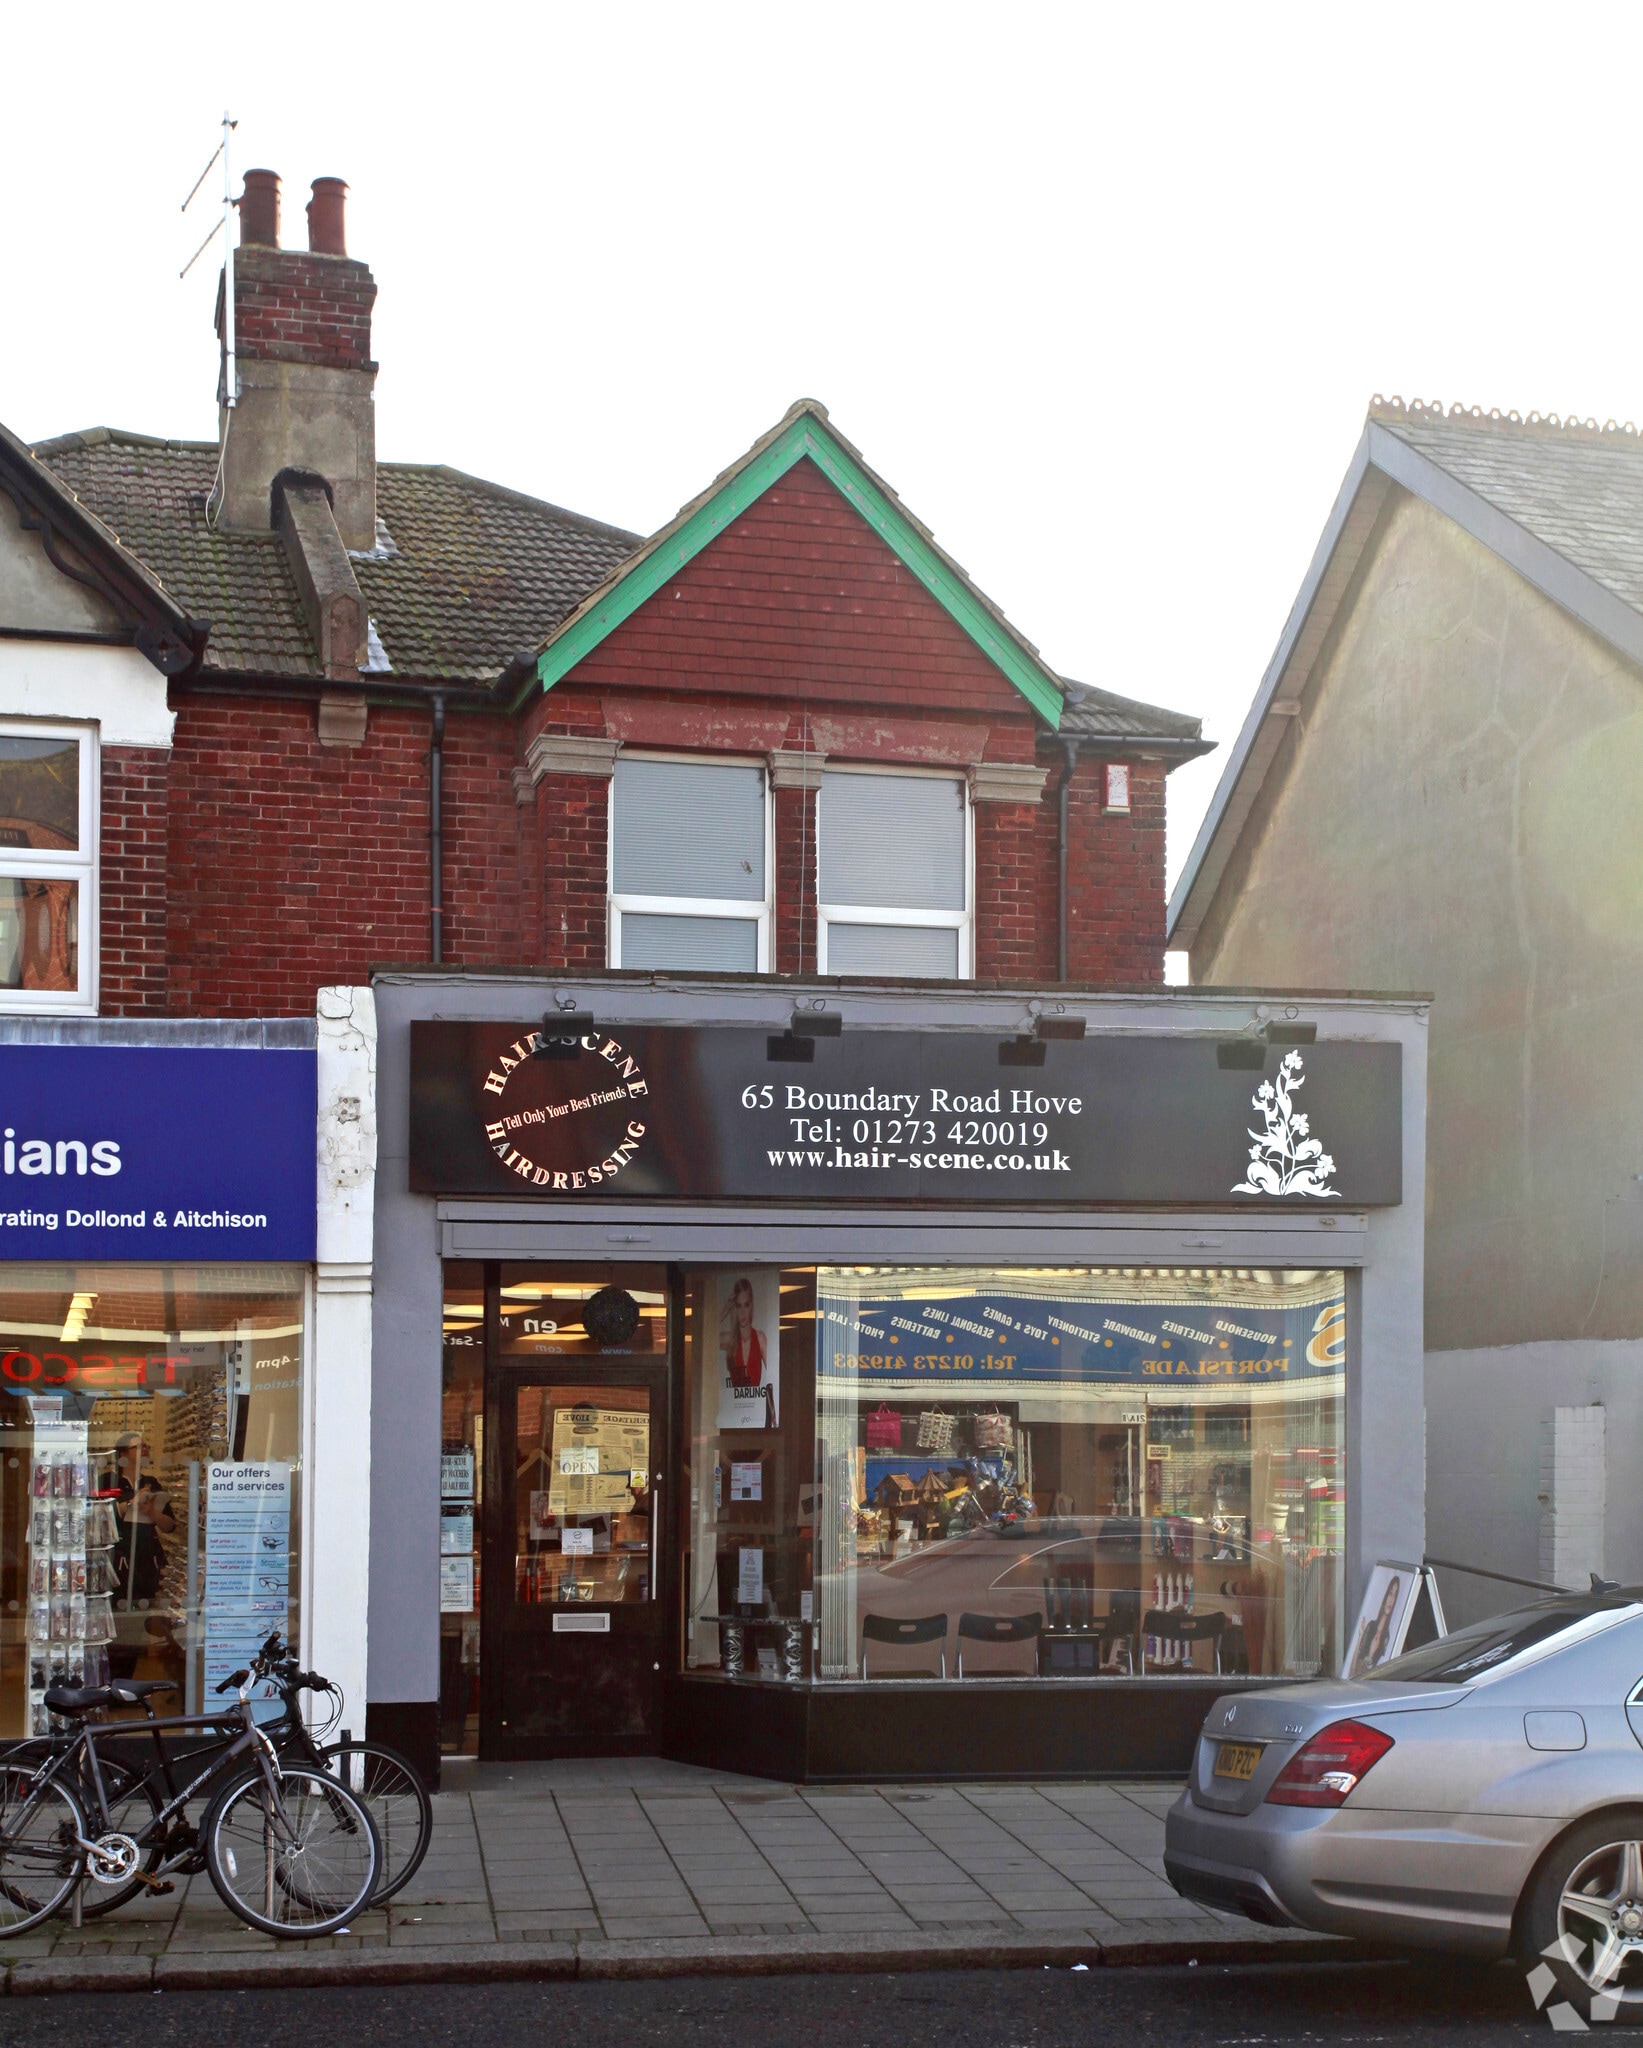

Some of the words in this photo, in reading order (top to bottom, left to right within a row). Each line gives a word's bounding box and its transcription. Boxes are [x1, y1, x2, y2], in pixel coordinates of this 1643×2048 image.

[503, 1115, 522, 1130] Tell
[523, 1108, 546, 1124] Only
[546, 1103, 569, 1119] Your
[569, 1096, 591, 1112] Best
[591, 1086, 627, 1106] Friends
[741, 1084, 774, 1110] 65
[785, 1085, 920, 1117] Boundary
[929, 1088, 1001, 1114] Road
[1010, 1089, 1082, 1115] Hove
[790, 1118, 842, 1143] Tel:
[853, 1119, 937, 1145] 01273
[947, 1121, 1048, 1146] 420019
[485, 1120, 646, 1190] HAIRDRESSING
[767, 1146, 1071, 1171] www.hair-scene.co.uk
[66, 1210, 145, 1228] Dollond
[153, 1211, 167, 1228] &
[173, 1210, 267, 1228] Aitchison
[734, 1386, 767, 1399] DARLING
[212, 1467, 234, 1478] Our
[237, 1467, 270, 1478] offers
[562, 1462, 596, 1474] OPEN
[212, 1481, 234, 1491] and
[237, 1481, 285, 1491] services
